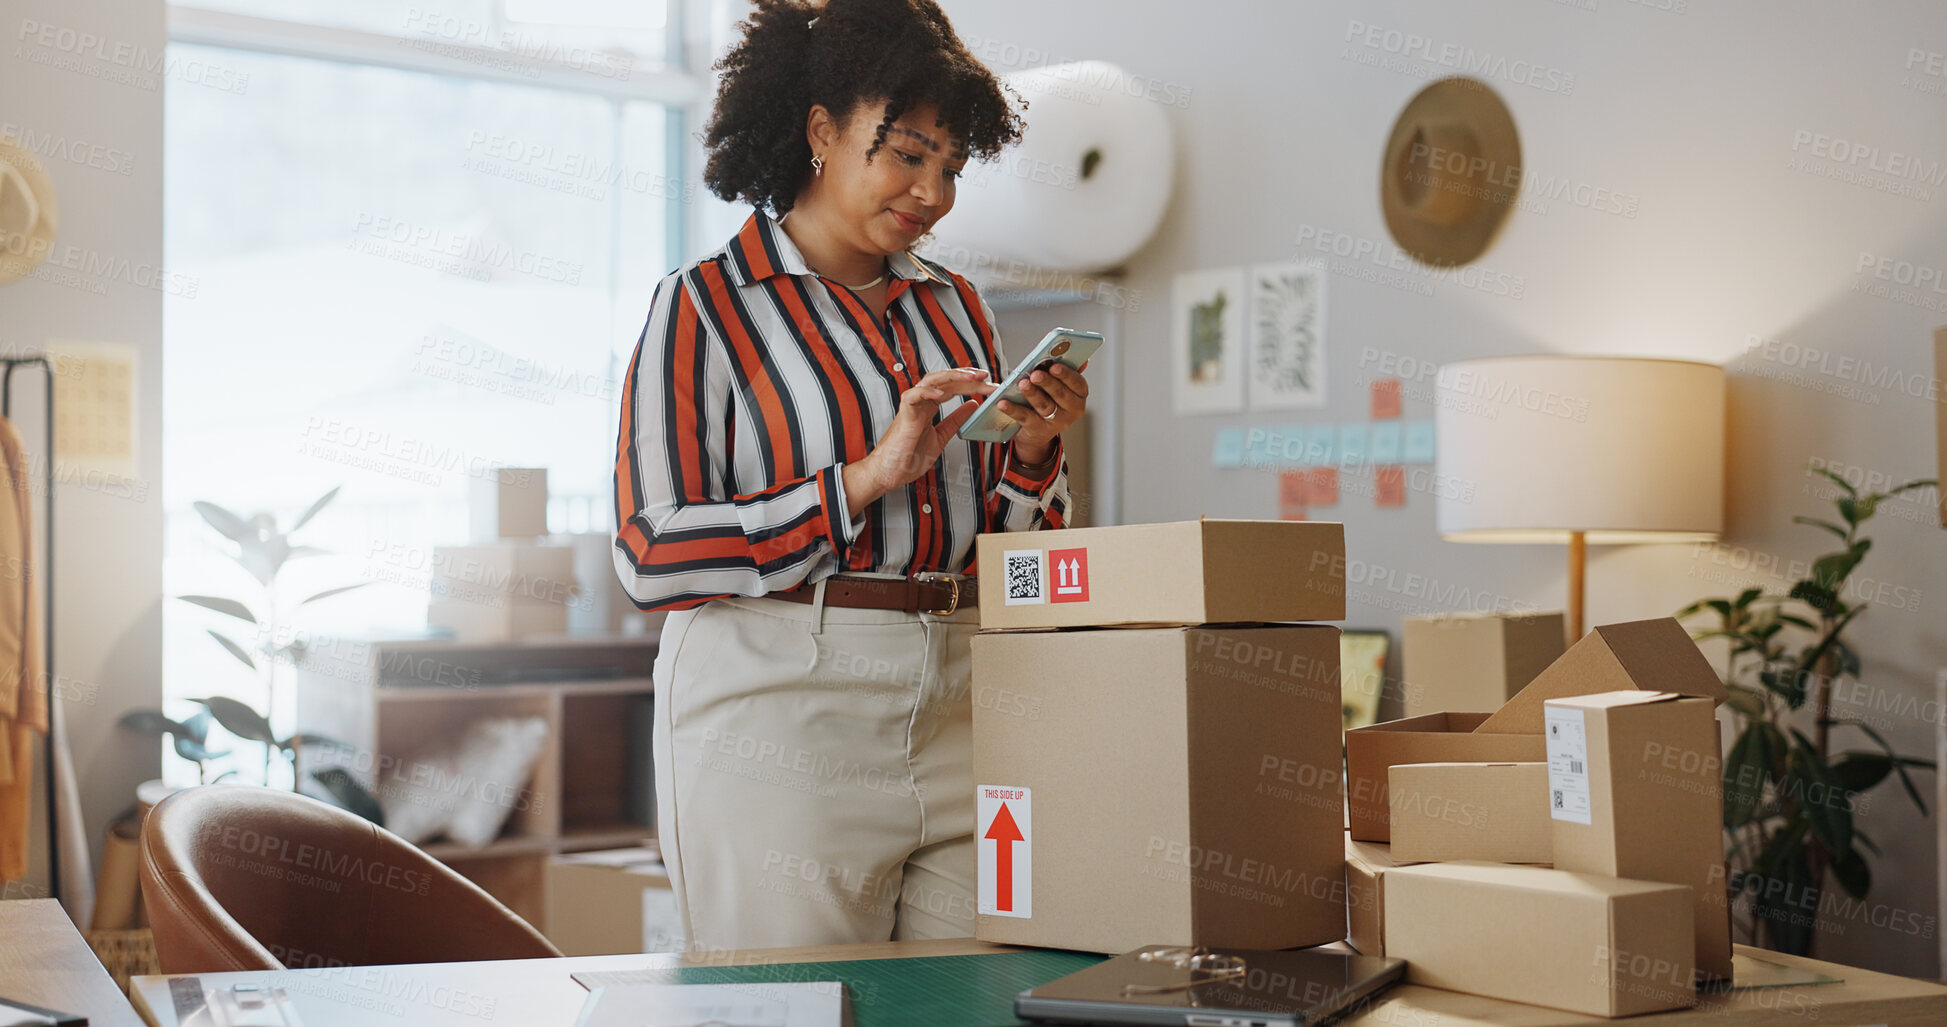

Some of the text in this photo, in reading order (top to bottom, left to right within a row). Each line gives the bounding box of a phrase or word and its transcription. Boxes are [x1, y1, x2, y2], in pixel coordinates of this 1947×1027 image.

[985, 789, 1024, 800] THIS SIDE UP
